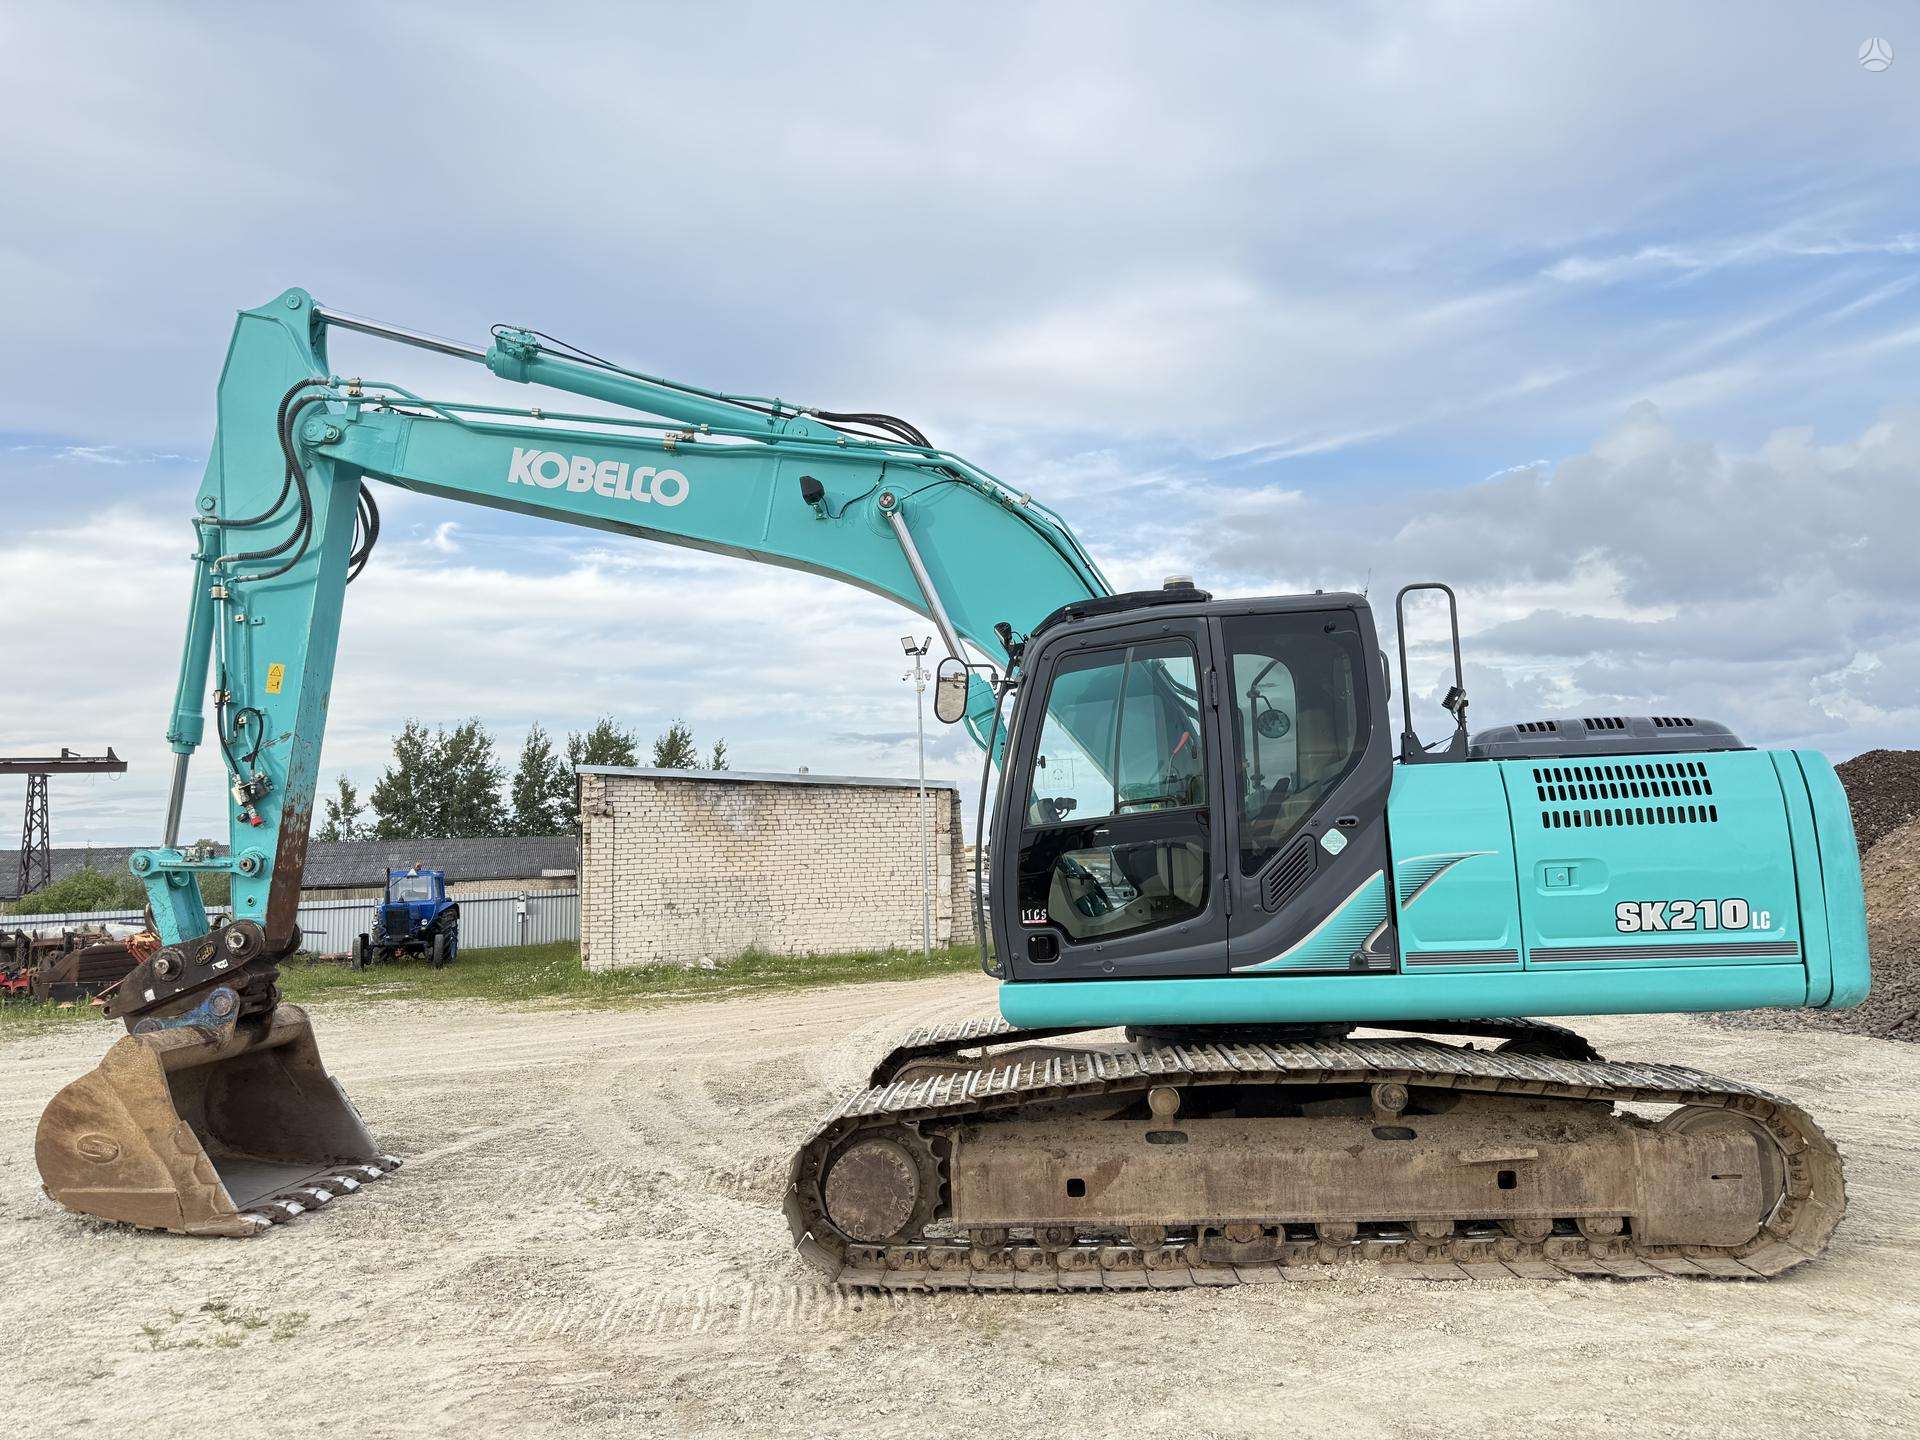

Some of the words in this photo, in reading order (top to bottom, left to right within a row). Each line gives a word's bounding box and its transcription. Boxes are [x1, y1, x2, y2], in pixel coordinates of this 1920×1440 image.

[507, 447, 690, 507] KOBELCO
[1615, 898, 1750, 933] SK210
[1752, 911, 1771, 930] LC
